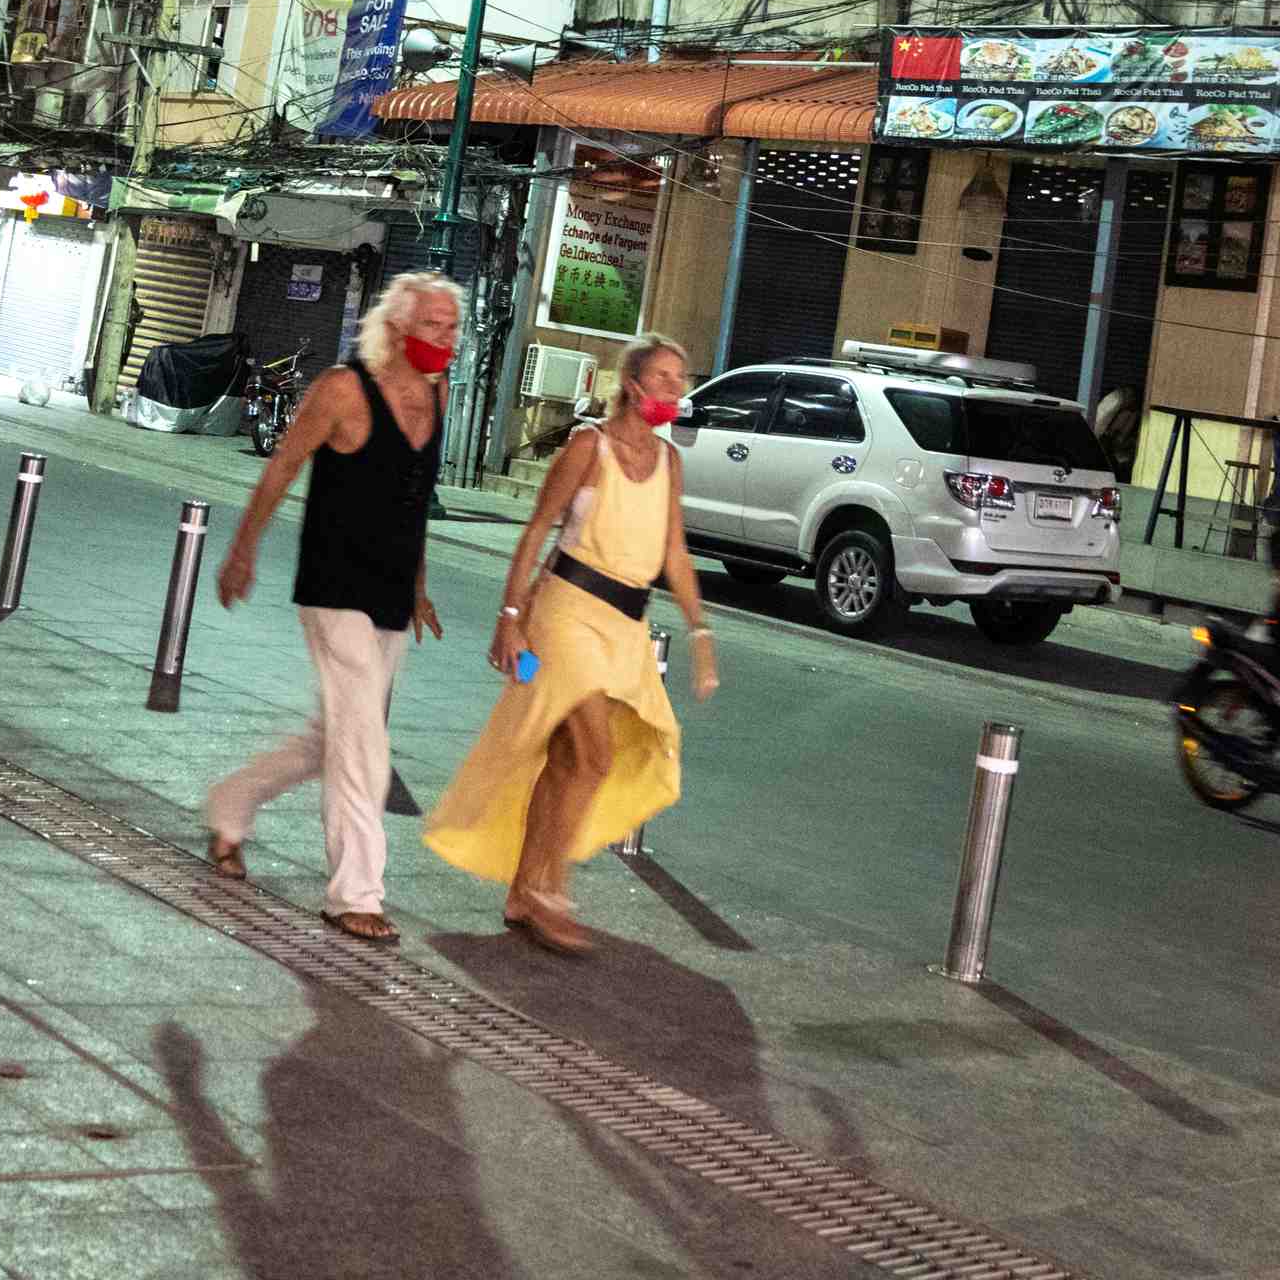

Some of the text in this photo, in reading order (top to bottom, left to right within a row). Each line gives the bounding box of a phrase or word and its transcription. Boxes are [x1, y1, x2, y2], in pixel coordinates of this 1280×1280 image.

[359, 12, 388, 34] SALE
[566, 204, 653, 236] Money Exchange
[562, 224, 648, 252] Échange de l'argent
[559, 243, 625, 268] Geldwechsel
